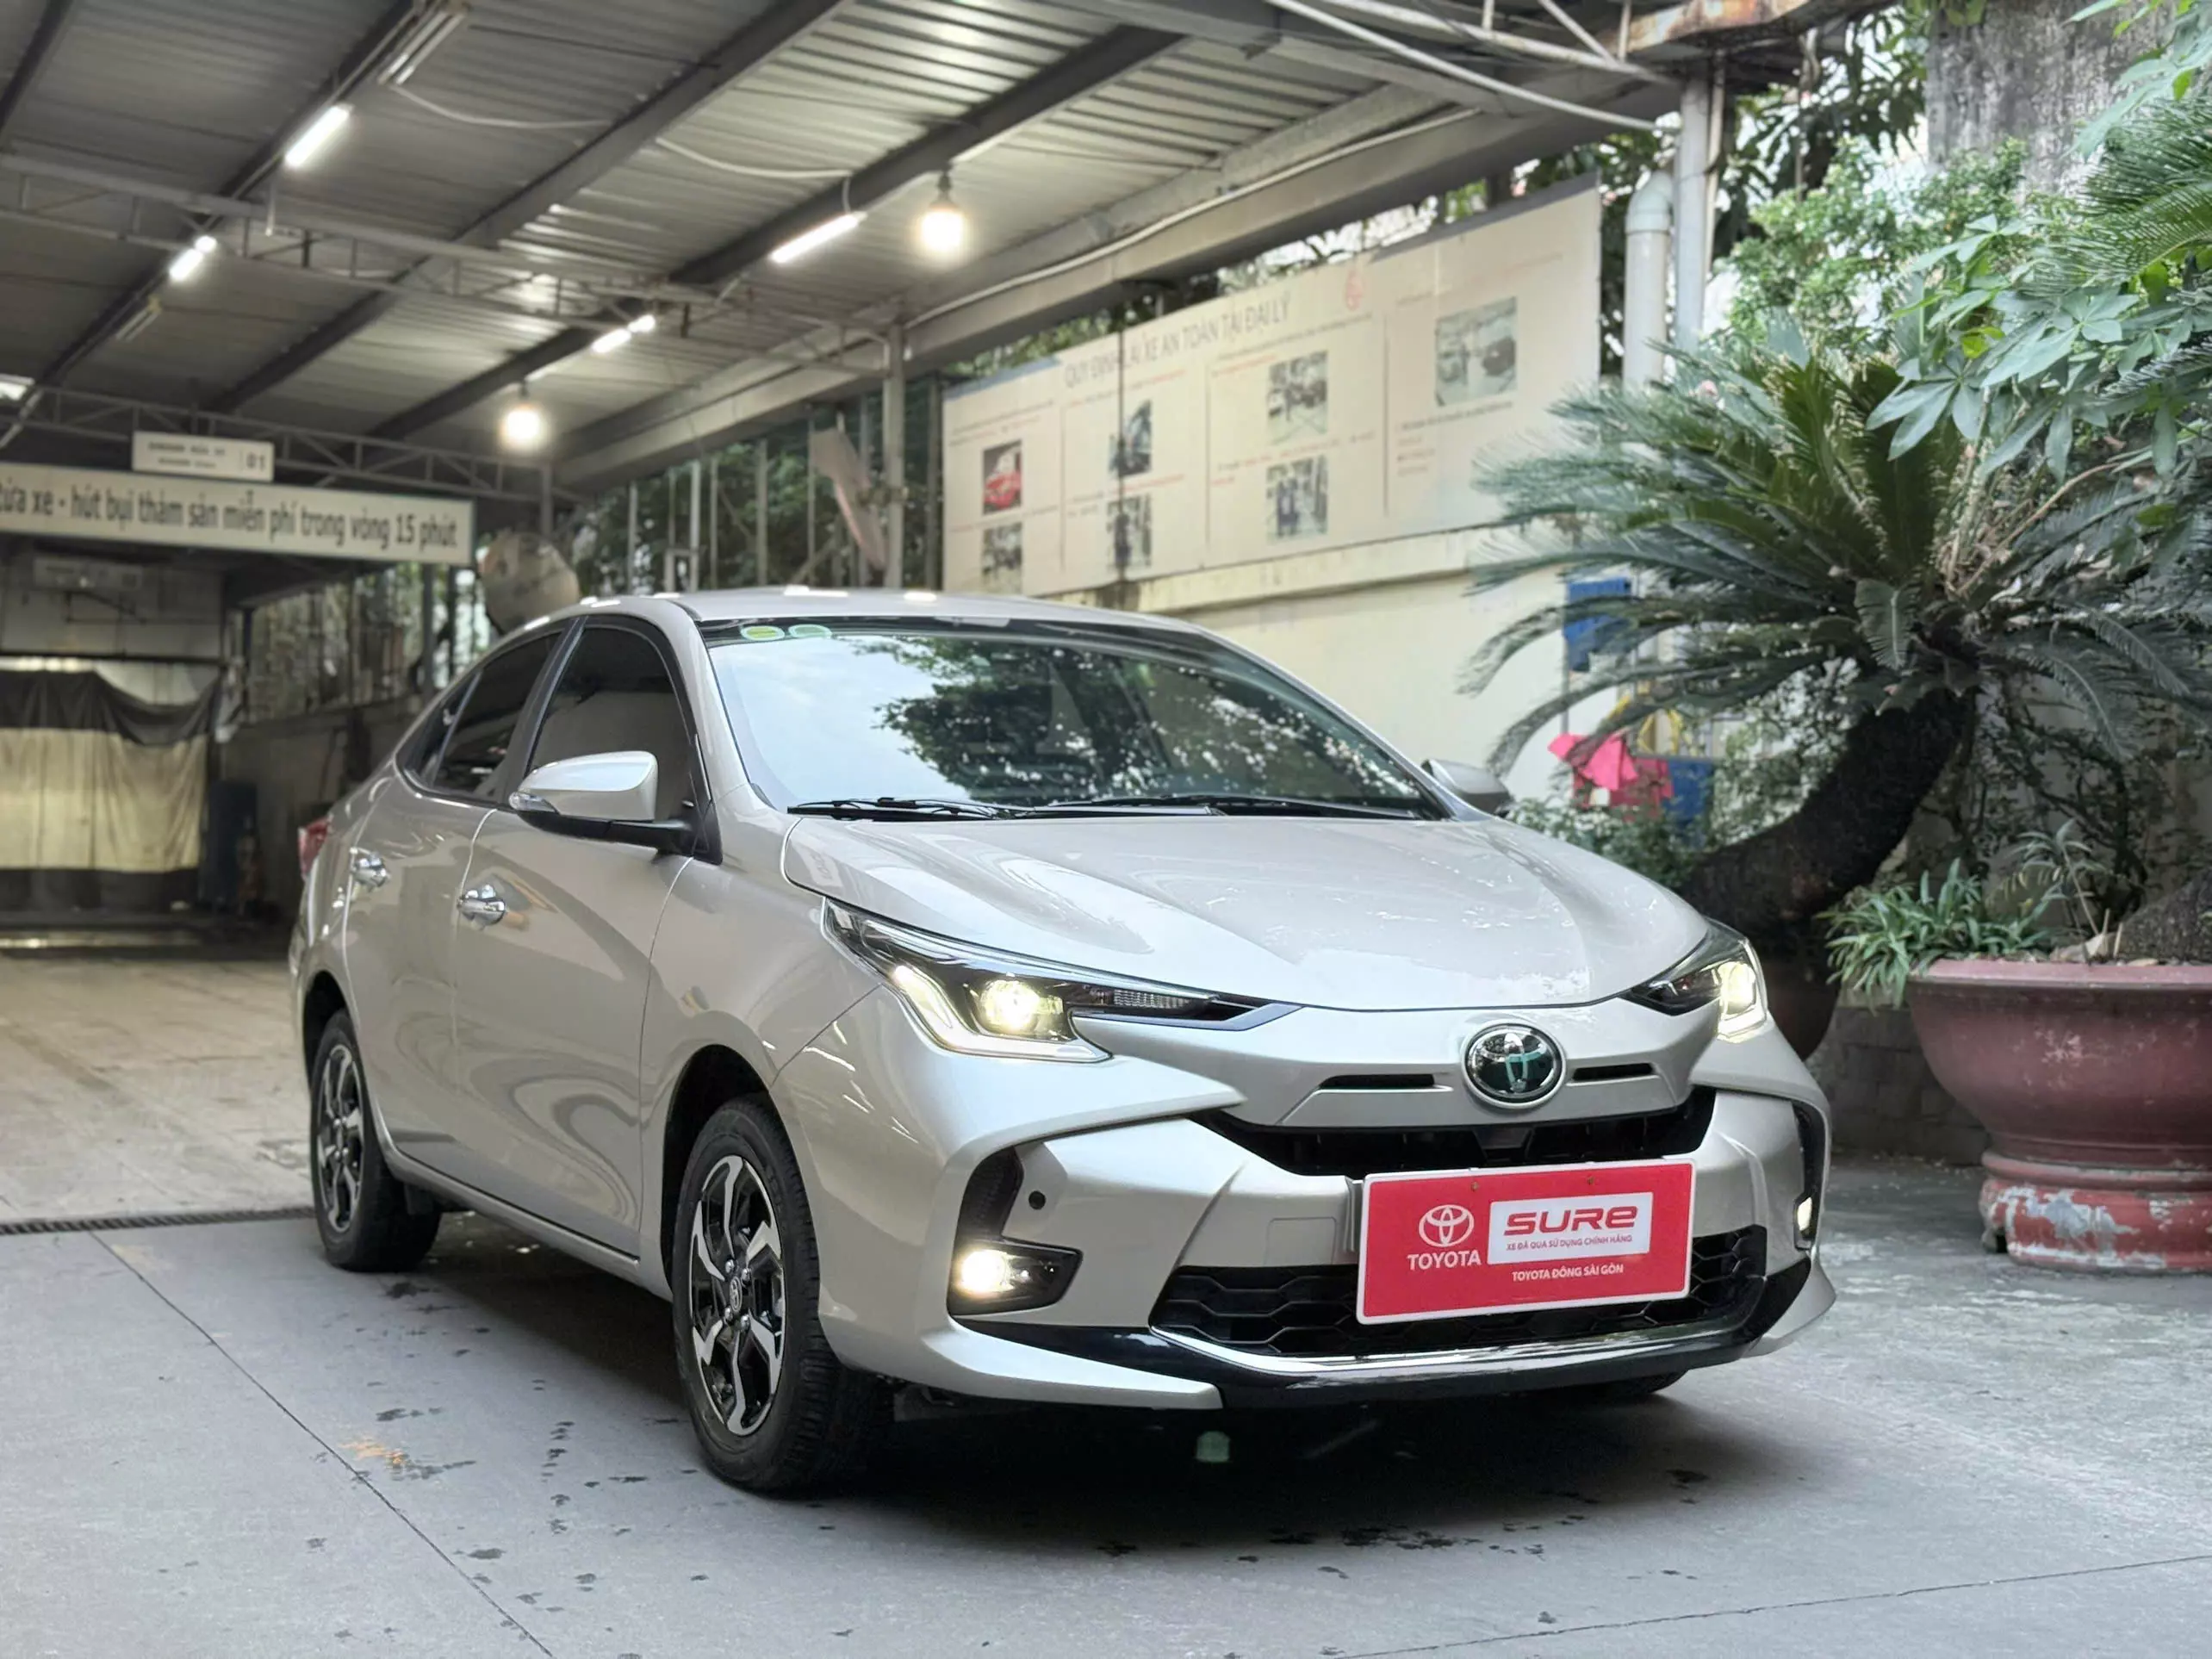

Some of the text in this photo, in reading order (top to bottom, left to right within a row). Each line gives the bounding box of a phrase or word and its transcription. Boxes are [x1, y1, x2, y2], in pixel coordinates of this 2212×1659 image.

[395, 513, 416, 544] 15
[1506, 1242, 1516, 1252] XE
[1530, 1240, 1548, 1249] QUA
[1560, 1238, 1583, 1249] DỤNG
[1583, 1235, 1609, 1246] CHÍNH
[1407, 1249, 1482, 1271] TOYOTA
[1512, 1261, 1625, 1283] TOYOTA ĐÔNG SÀI GÒN
